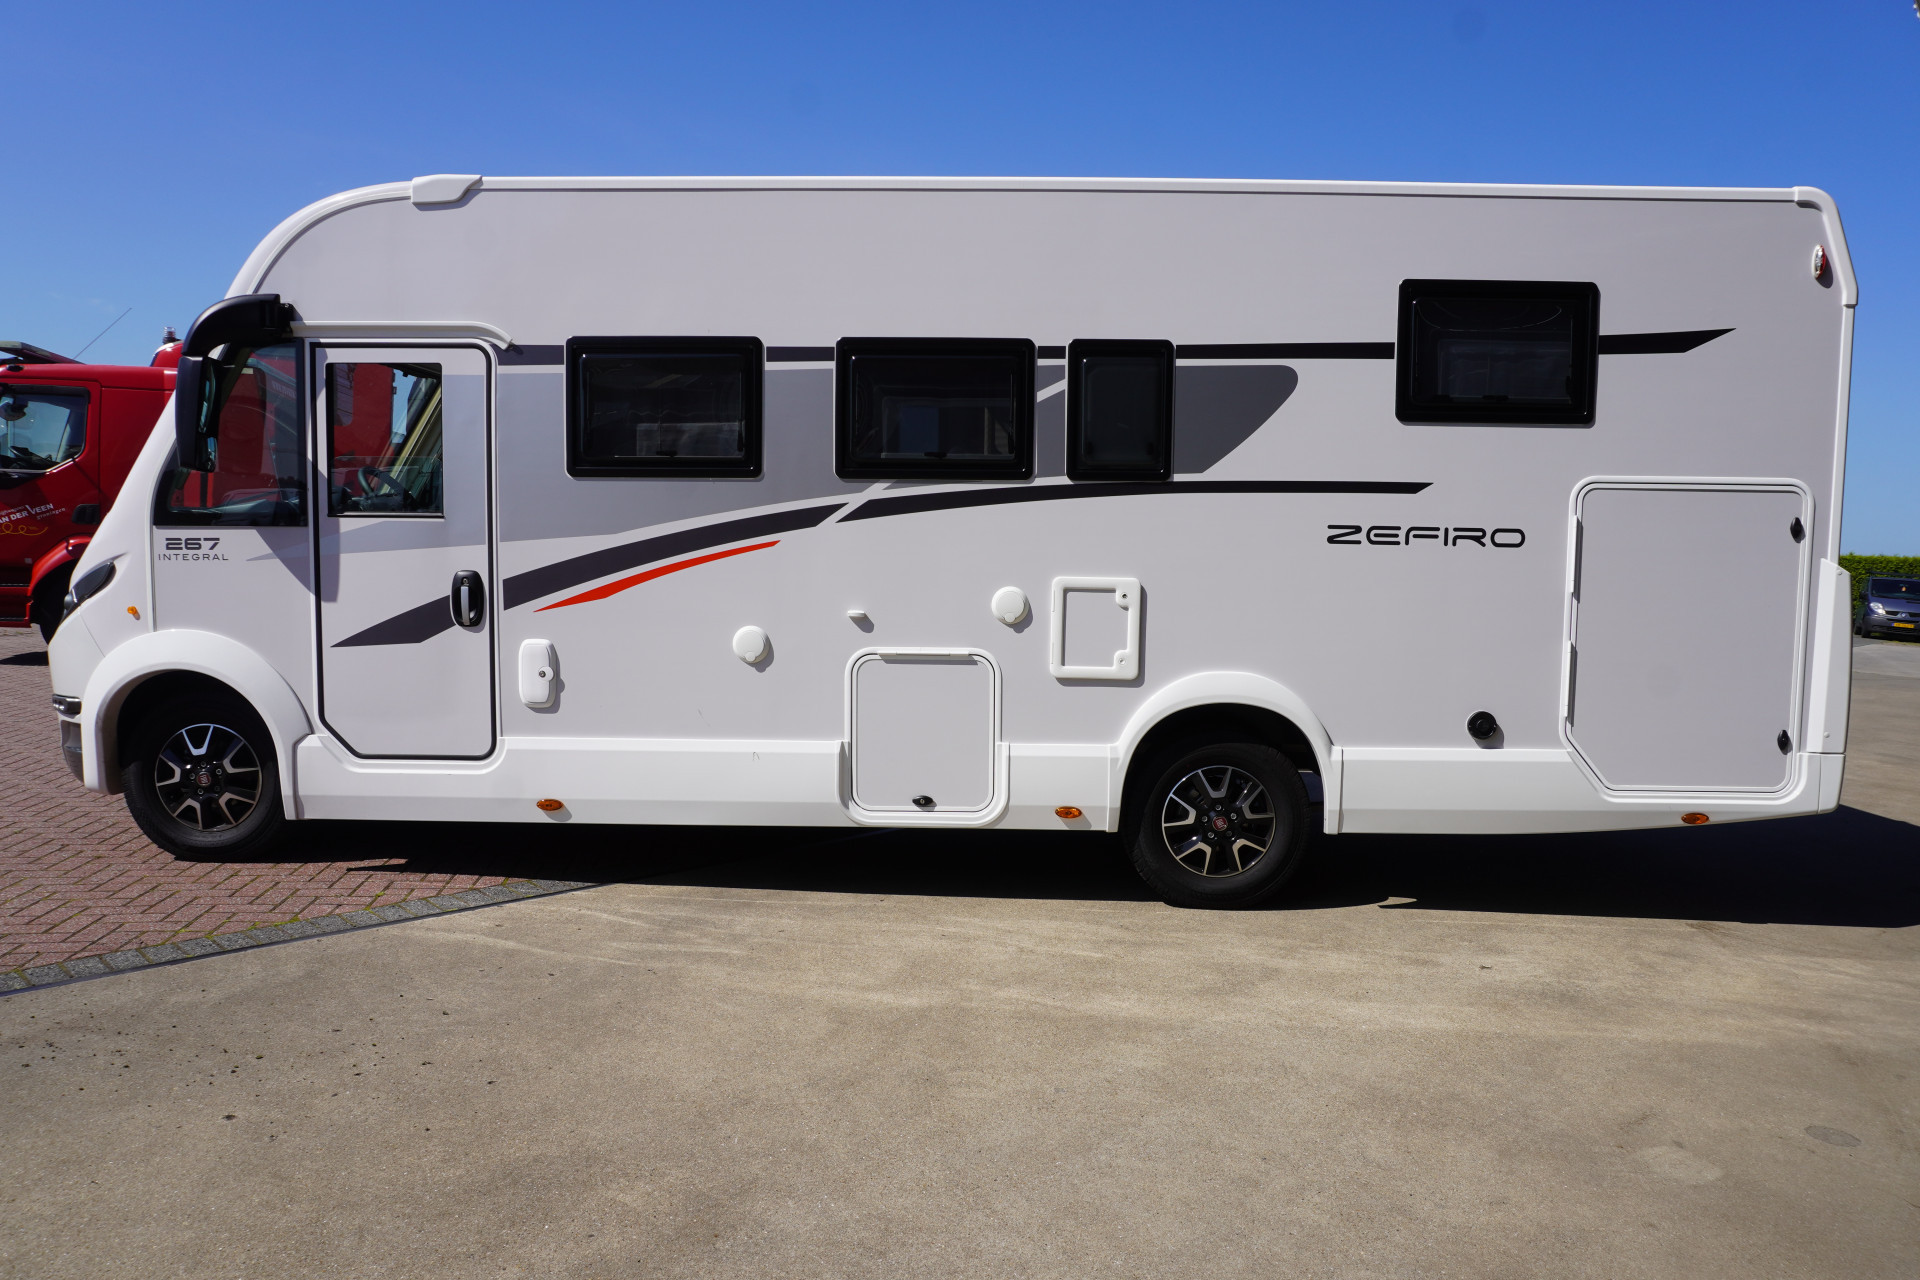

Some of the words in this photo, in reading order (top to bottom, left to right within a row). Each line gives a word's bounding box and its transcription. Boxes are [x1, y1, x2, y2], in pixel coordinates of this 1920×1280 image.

[10, 511, 29, 520] DER
[25, 504, 54, 514] VEEN
[1327, 524, 1526, 548] ZEFIRO
[165, 537, 220, 551] 267
[158, 553, 229, 561] INTEGRAL
